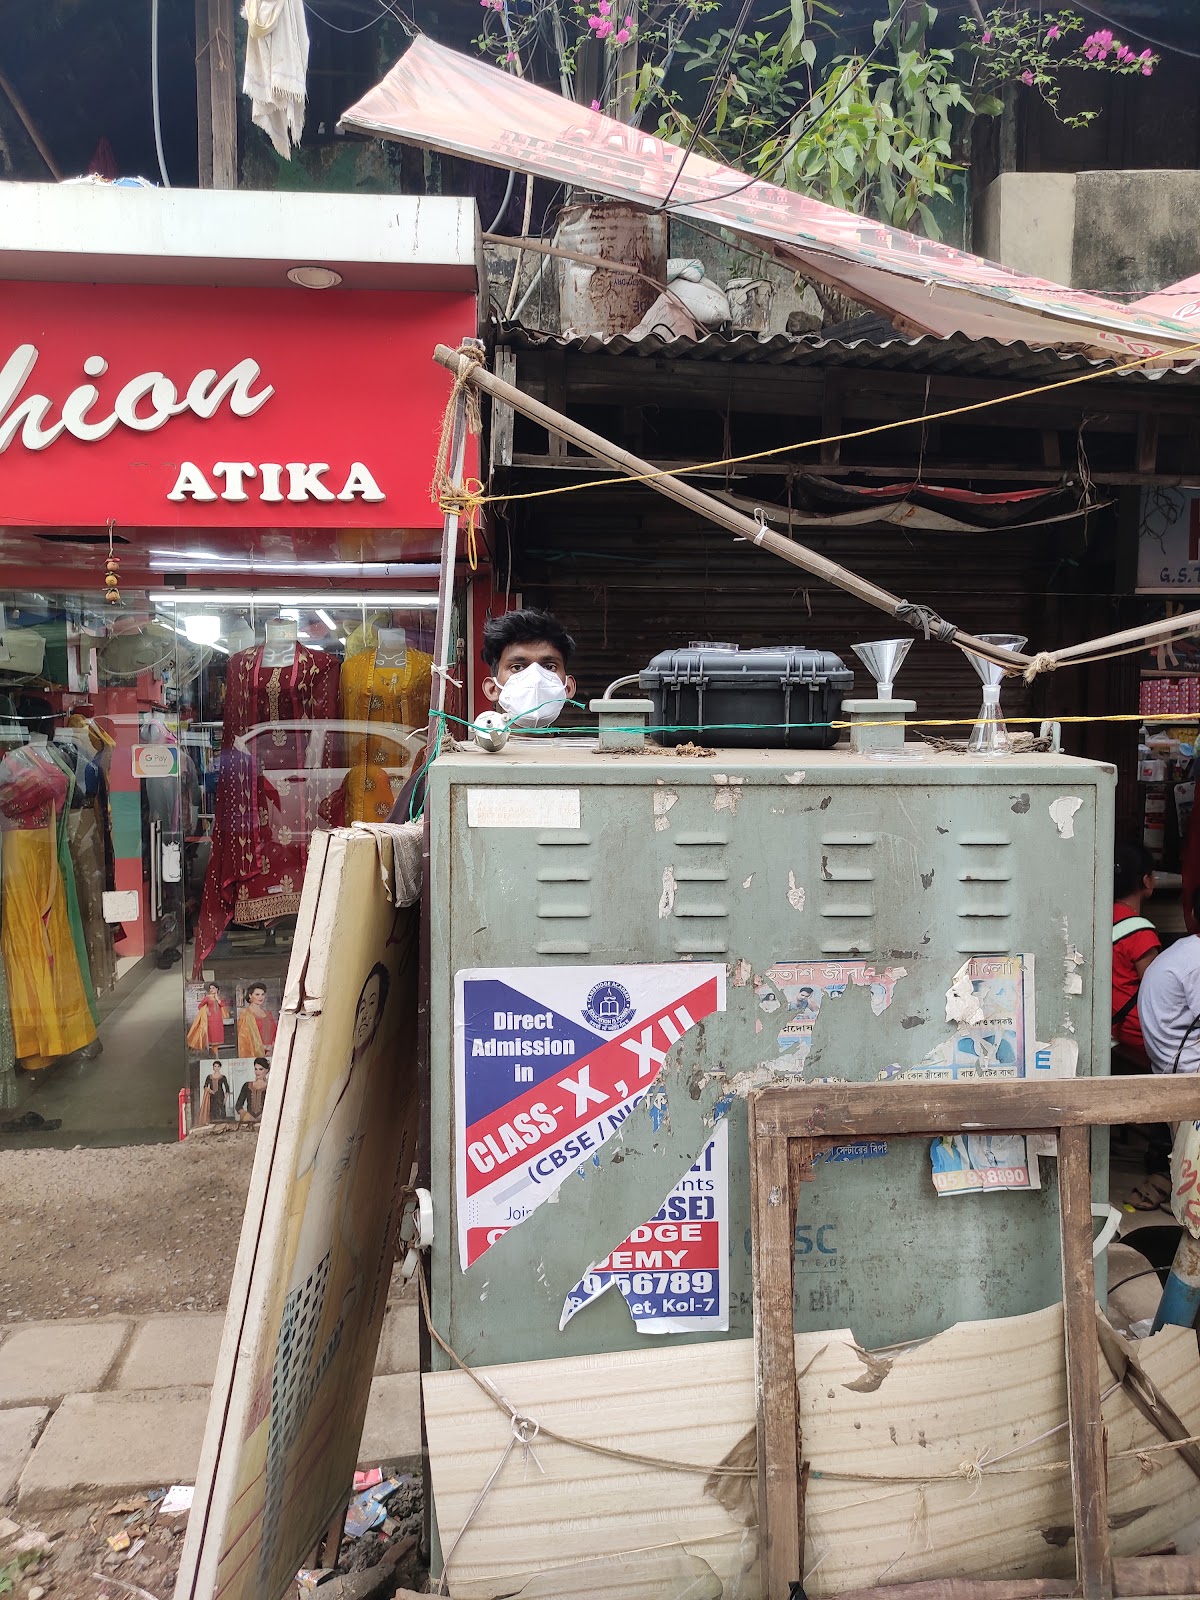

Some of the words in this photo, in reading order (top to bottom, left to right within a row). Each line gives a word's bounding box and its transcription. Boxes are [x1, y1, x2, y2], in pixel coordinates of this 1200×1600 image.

[167, 461, 387, 503] ATIKA
[494, 1011, 554, 1030] Direct
[471, 1036, 576, 1057] Admission
[514, 1063, 534, 1082] in
[630, 1224, 703, 1243] DGE
[662, 1298, 715, 1314] Kol-7
